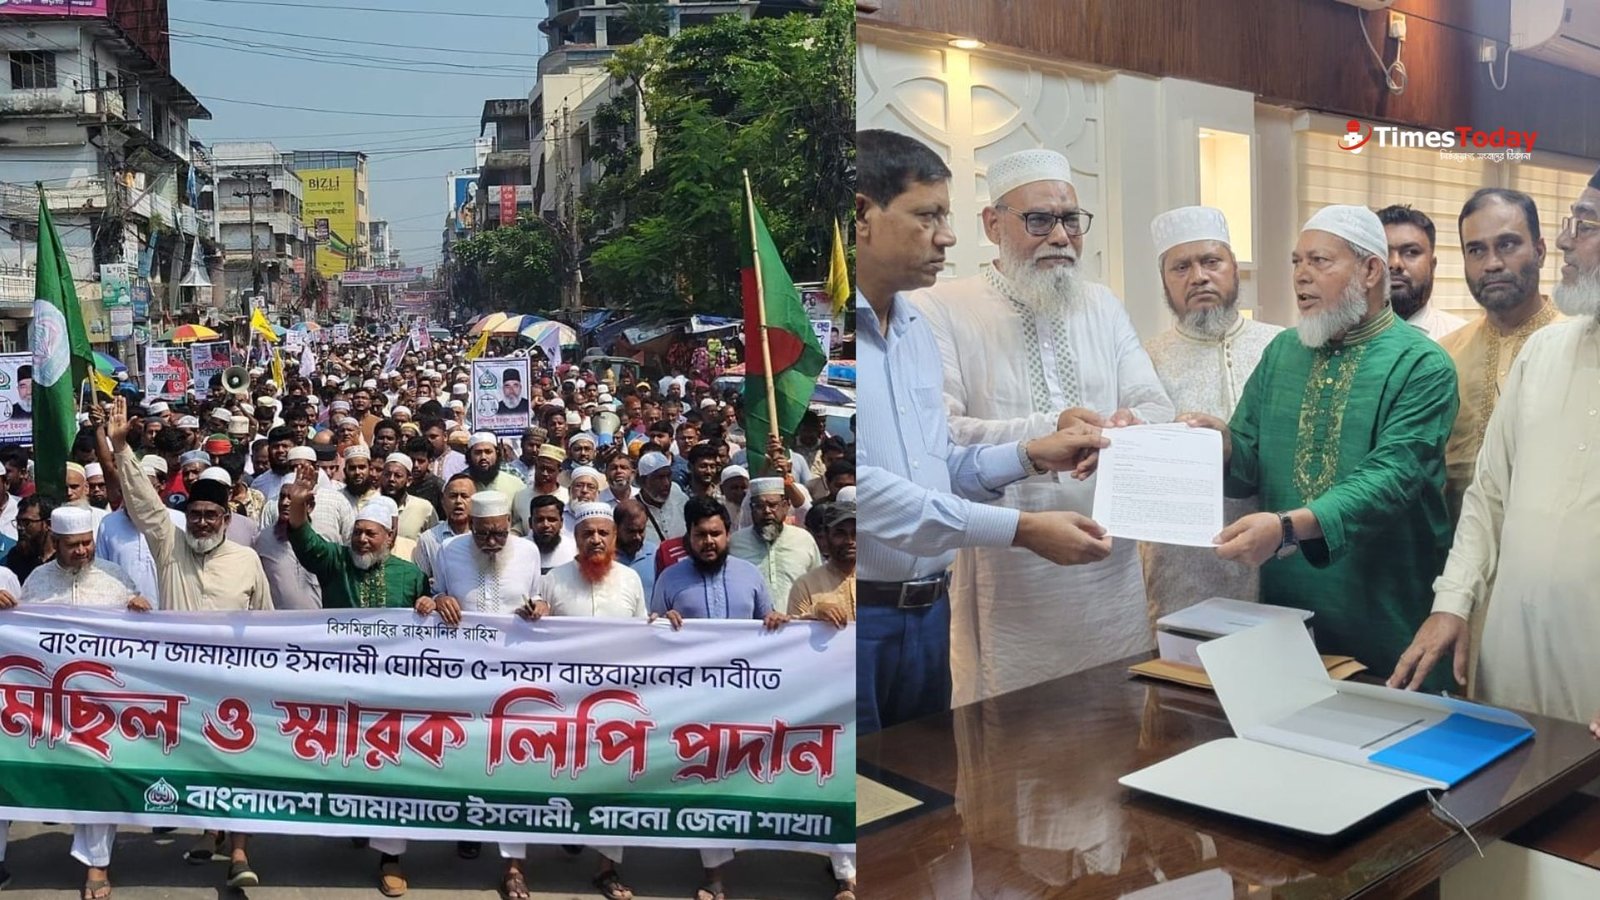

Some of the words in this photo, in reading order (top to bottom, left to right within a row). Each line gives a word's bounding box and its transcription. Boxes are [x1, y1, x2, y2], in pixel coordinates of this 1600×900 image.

[327, 617, 397, 638] বিসমিল্লাহির
[463, 624, 499, 642] রাহিম
[39, 631, 160, 660] বাংলাদেশ
[164, 641, 280, 669] জামায়াতে
[285, 643, 378, 675] ইসলামী
[384, 648, 465, 679] ঘোষিত
[470, 659, 553, 683] ৫-দফা
[558, 662, 696, 689] বাস্তবায়নের
[700, 658, 782, 690] দাবীতে
[201, 697, 257, 753] ও
[271, 699, 475, 769] স্মারক
[483, 685, 657, 782] লিপি
[669, 716, 845, 787] প্রদান
[185, 784, 324, 816] বাংলাদেশ
[328, 791, 461, 825] জামায়াতে
[466, 794, 580, 833] ইসলামী,
[588, 804, 671, 832] পাবনা
[676, 807, 753, 834] জেলা
